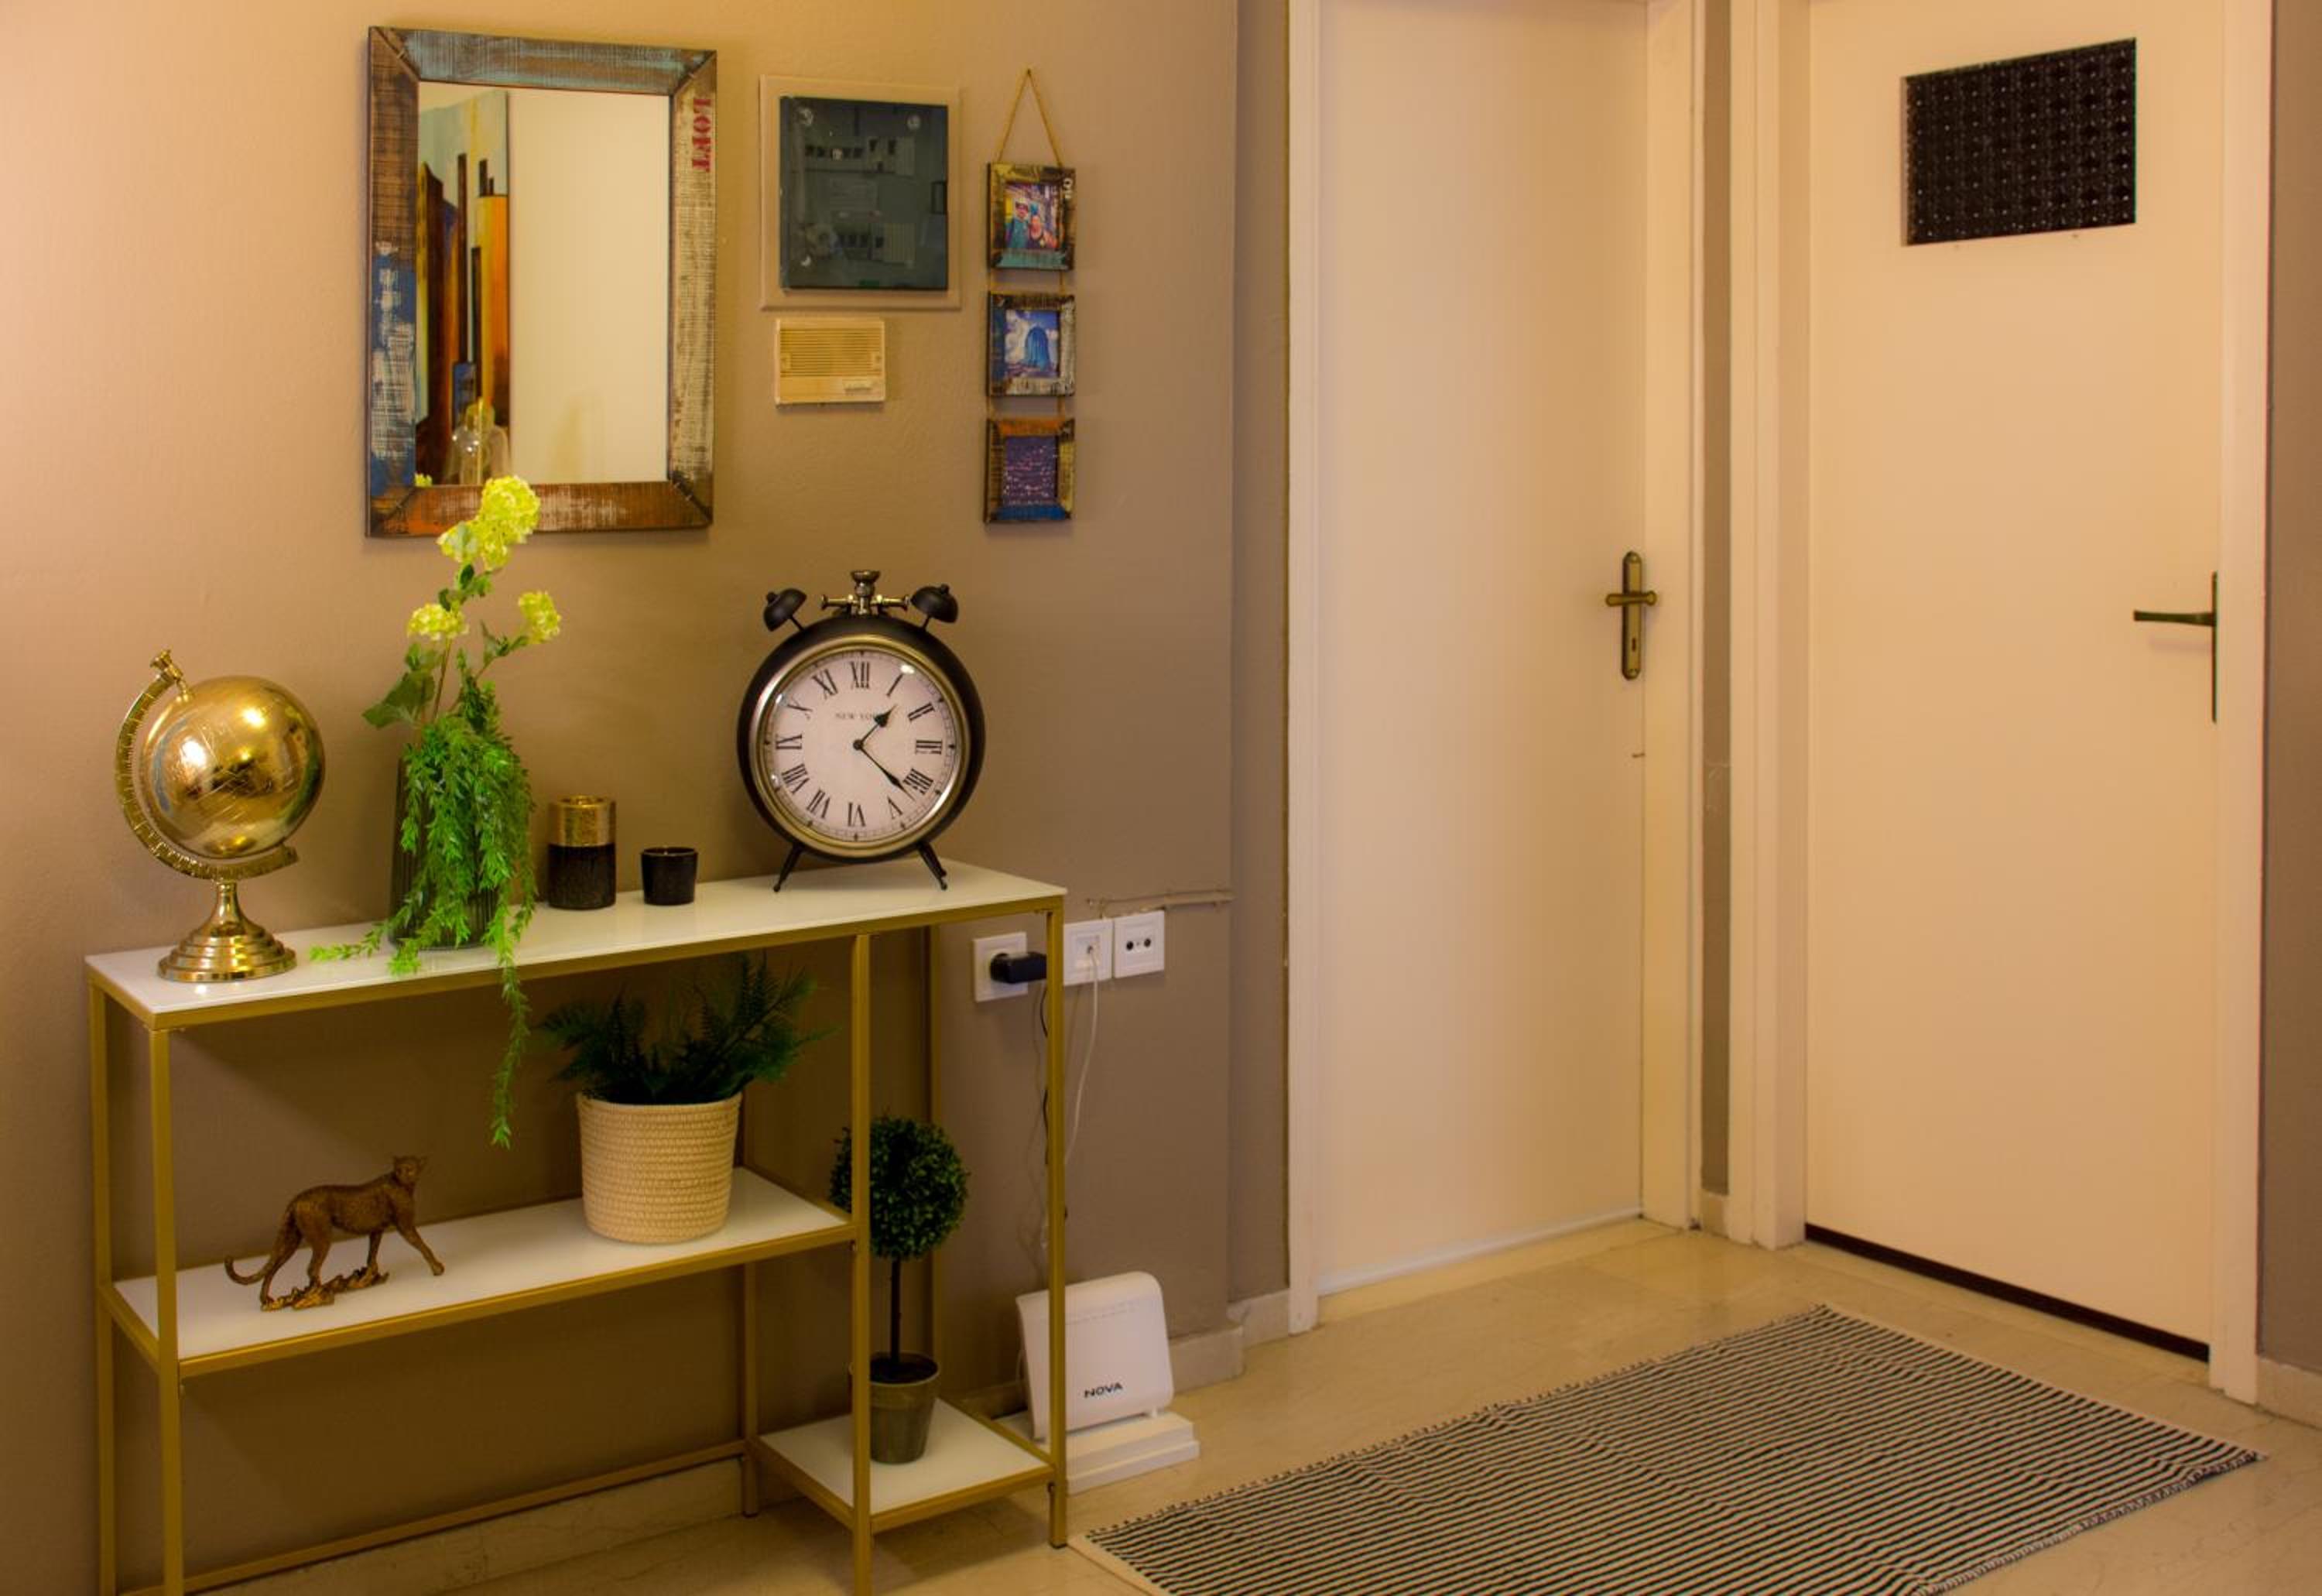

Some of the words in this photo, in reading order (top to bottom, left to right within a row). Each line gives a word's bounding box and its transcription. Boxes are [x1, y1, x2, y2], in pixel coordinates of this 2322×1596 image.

[693, 98, 711, 173] LOFT
[812, 669, 838, 700] XI
[849, 662, 870, 689] XII
[908, 702, 935, 721] II
[916, 740, 942, 755] III
[1084, 1382, 1123, 1398] NOVA
